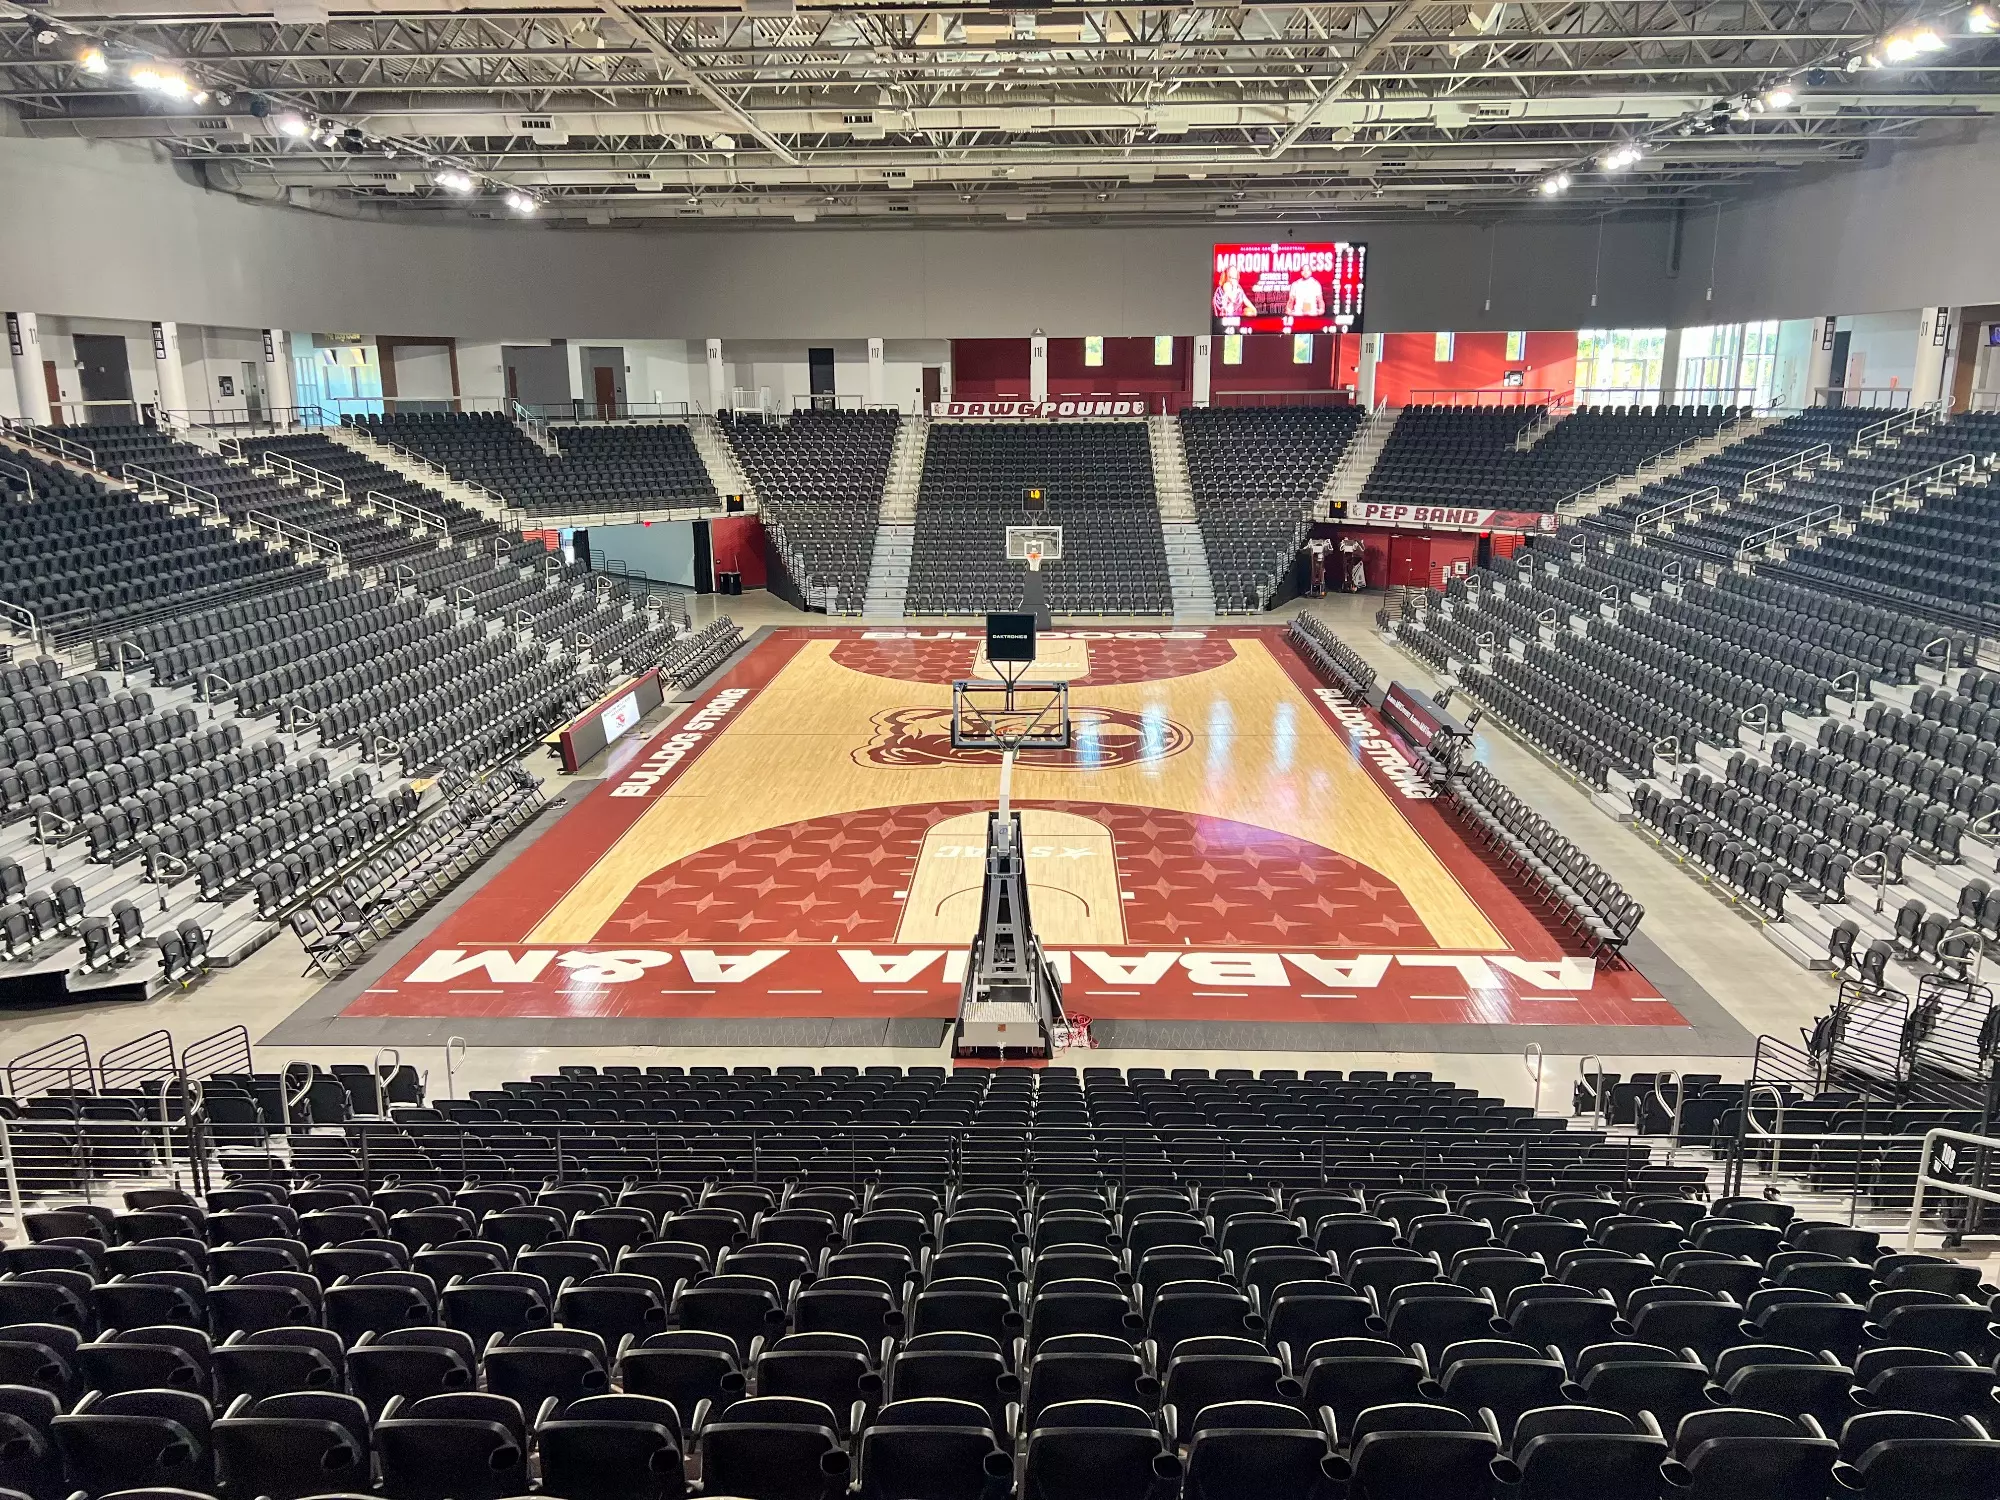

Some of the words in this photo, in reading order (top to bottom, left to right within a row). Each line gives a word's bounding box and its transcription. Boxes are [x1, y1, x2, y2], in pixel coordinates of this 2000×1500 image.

[1217, 252, 1269, 272] MAROON
[1273, 251, 1333, 272] MADNESS
[947, 402, 1036, 416] DAWG
[1041, 401, 1130, 416] POUND
[1365, 504, 1408, 520] PEP
[1413, 507, 1479, 525] BAND
[861, 631, 1207, 640] BULDOGS
[609, 732, 703, 797] BULLDOG
[682, 688, 751, 731] STRONG
[1313, 688, 1381, 737] BULLDOG
[1358, 739, 1438, 799] STRONG
[403, 949, 791, 984] A&M
